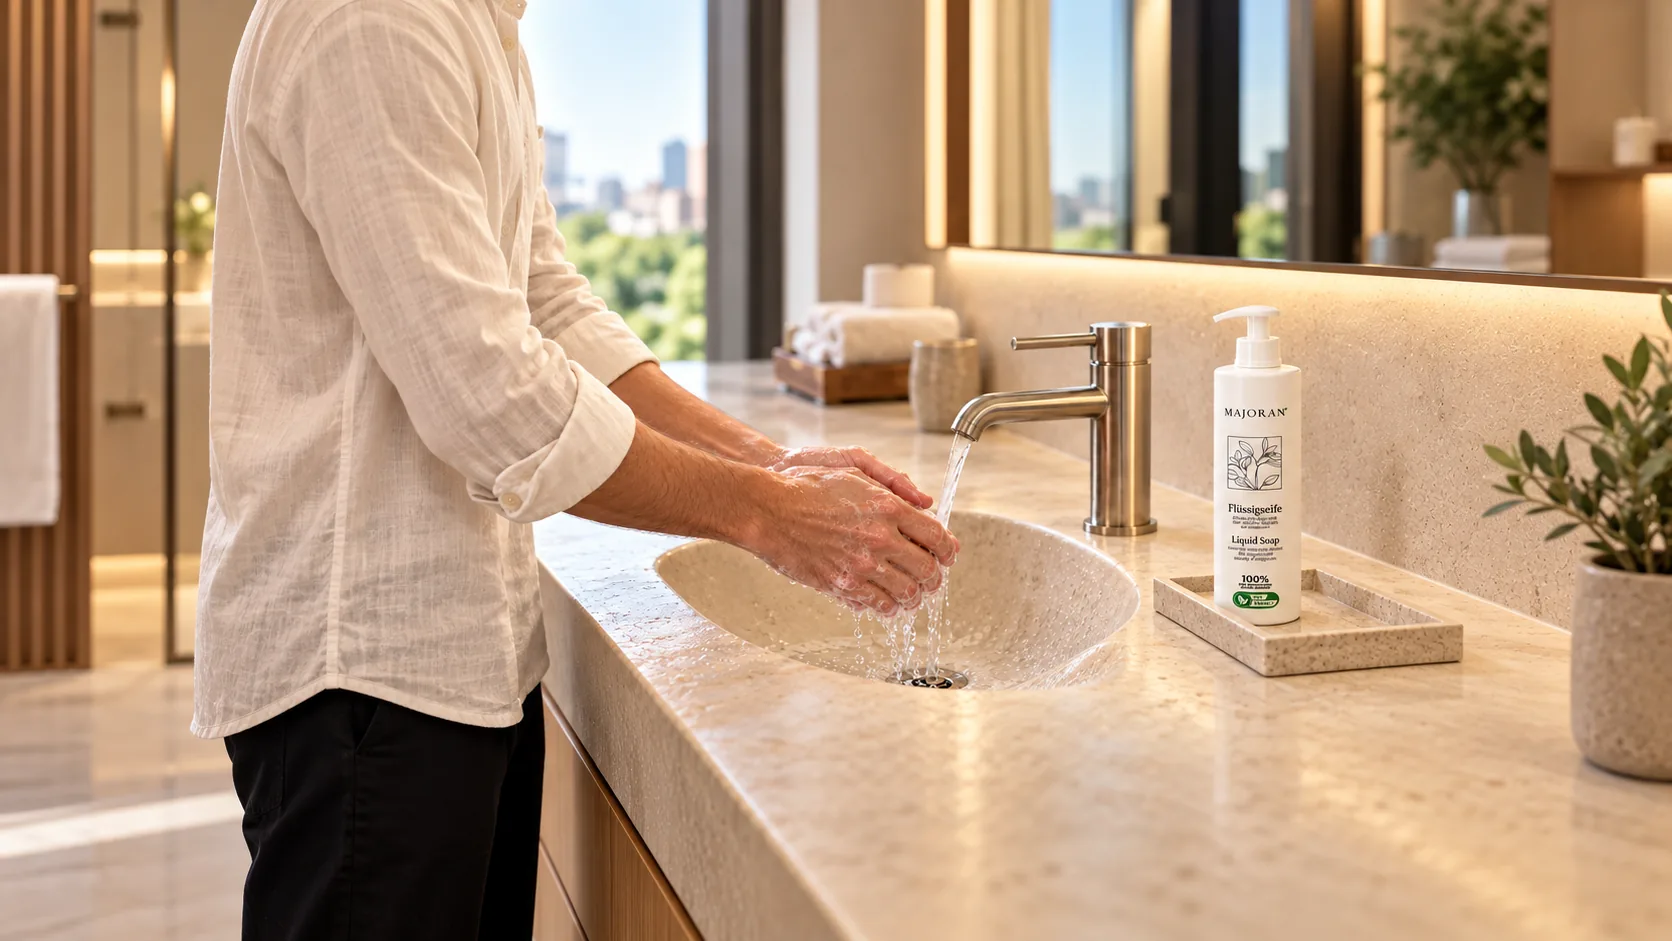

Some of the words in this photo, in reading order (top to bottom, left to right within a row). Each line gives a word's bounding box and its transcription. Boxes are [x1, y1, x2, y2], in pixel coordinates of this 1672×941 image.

[1224, 407, 1286, 419] MAJORAN
[1228, 503, 1283, 516] Flüssigseife
[1232, 535, 1258, 546] Liquid
[1259, 536, 1280, 547] Soap
[1241, 575, 1269, 583] 100%
